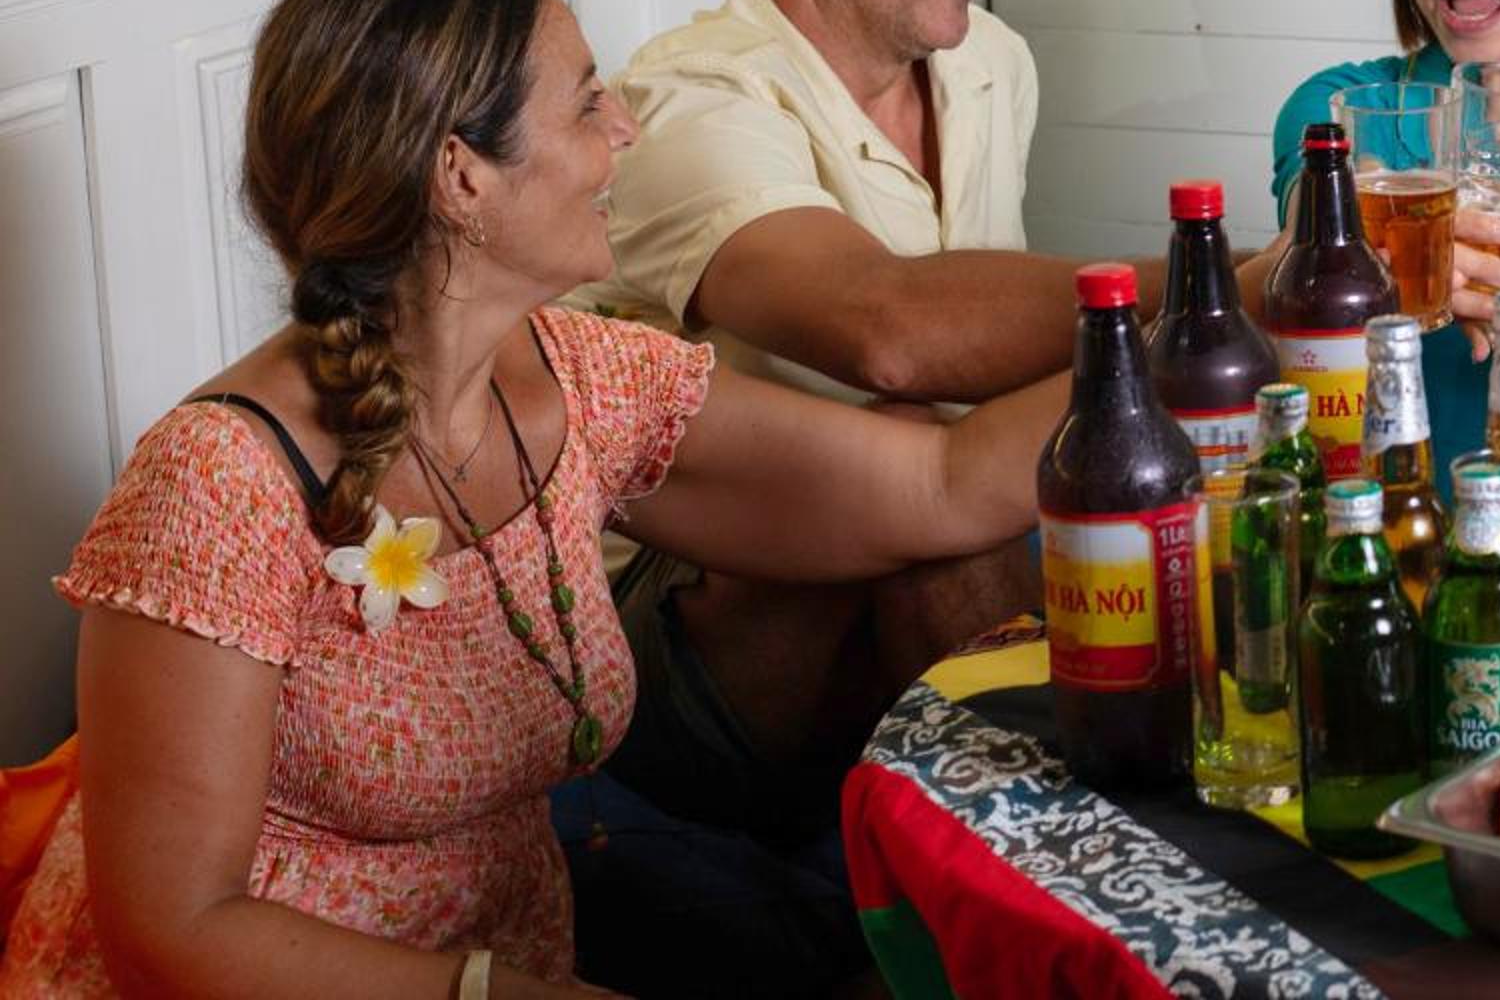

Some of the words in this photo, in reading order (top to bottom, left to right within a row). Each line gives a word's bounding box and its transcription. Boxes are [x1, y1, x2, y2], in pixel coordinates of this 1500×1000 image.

[1317, 387, 1350, 417] HÀ
[1095, 583, 1145, 624] NỘI
[1461, 718, 1487, 730] BIA
